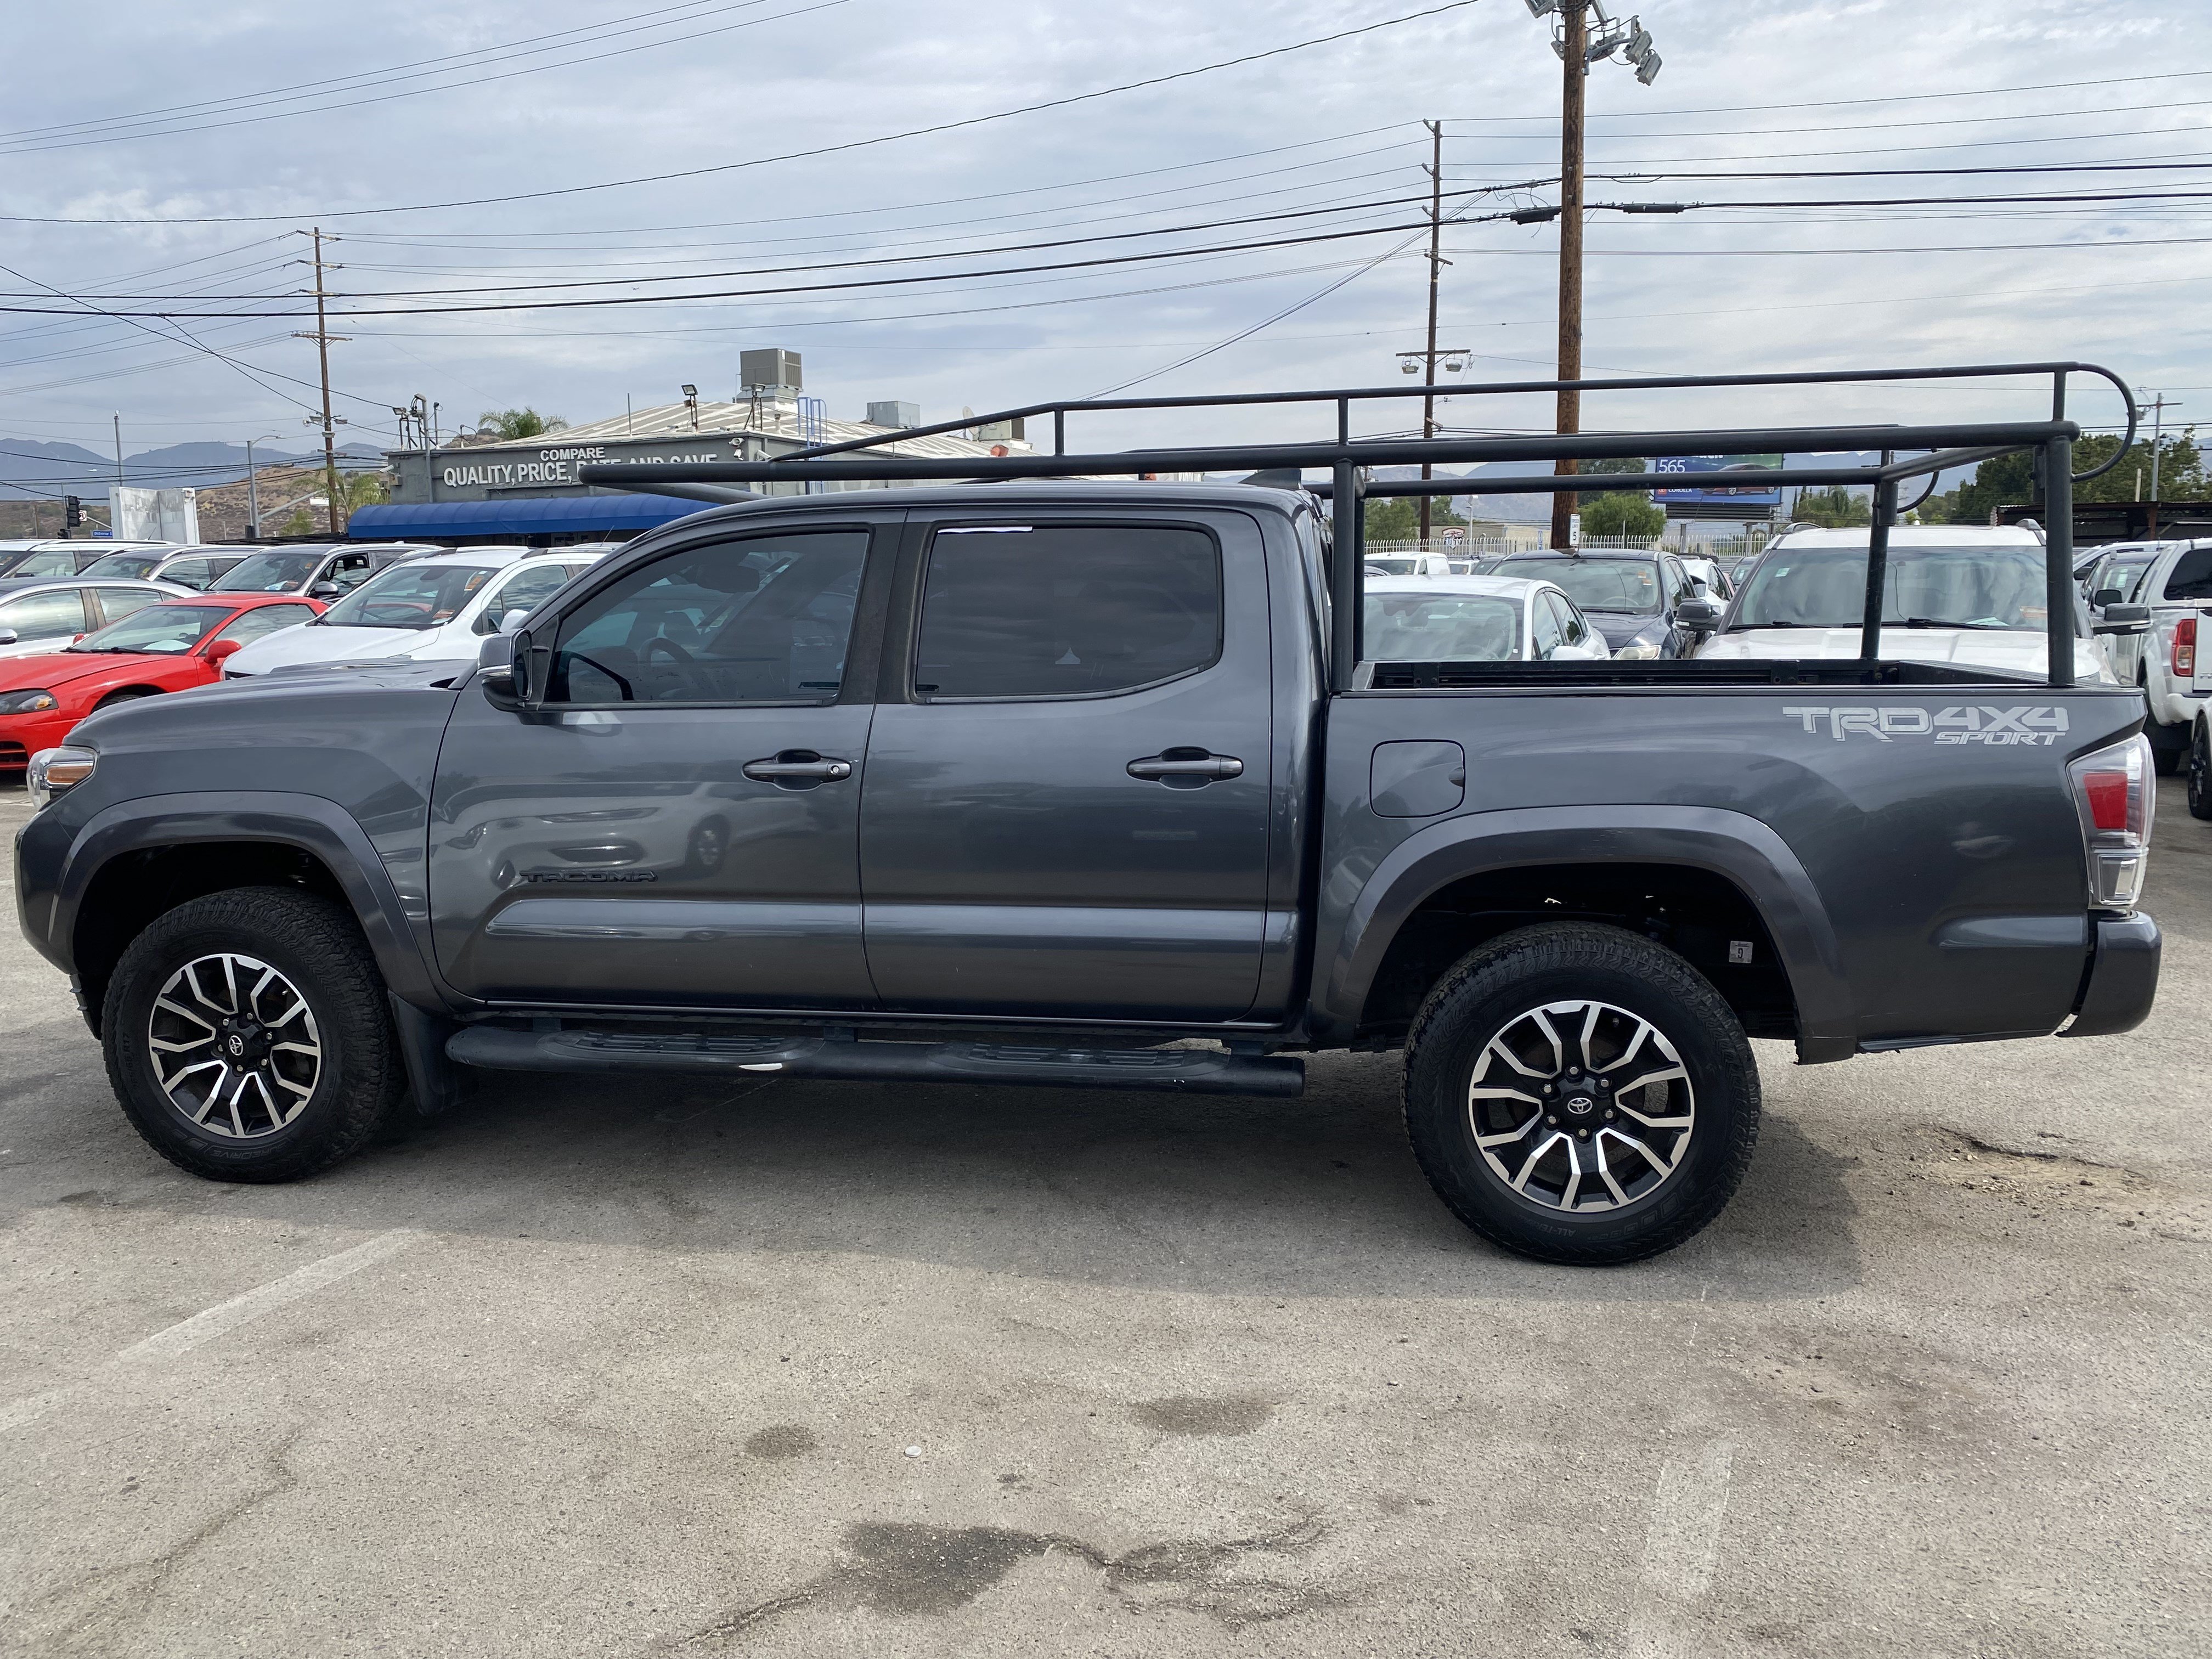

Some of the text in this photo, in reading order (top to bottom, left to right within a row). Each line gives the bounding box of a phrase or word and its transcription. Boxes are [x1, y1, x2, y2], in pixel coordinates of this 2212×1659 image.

[540, 447, 606, 461] COMPARE
[1658, 459, 1686, 473] 565
[443, 464, 516, 488] QUALITY,
[517, 461, 572, 484] PRICE,
[1573, 532, 1577, 541] 5
[1782, 706, 2070, 742] TRD 4X4
[1933, 731, 2066, 746] SPORT
[519, 871, 658, 883] TACOMA
